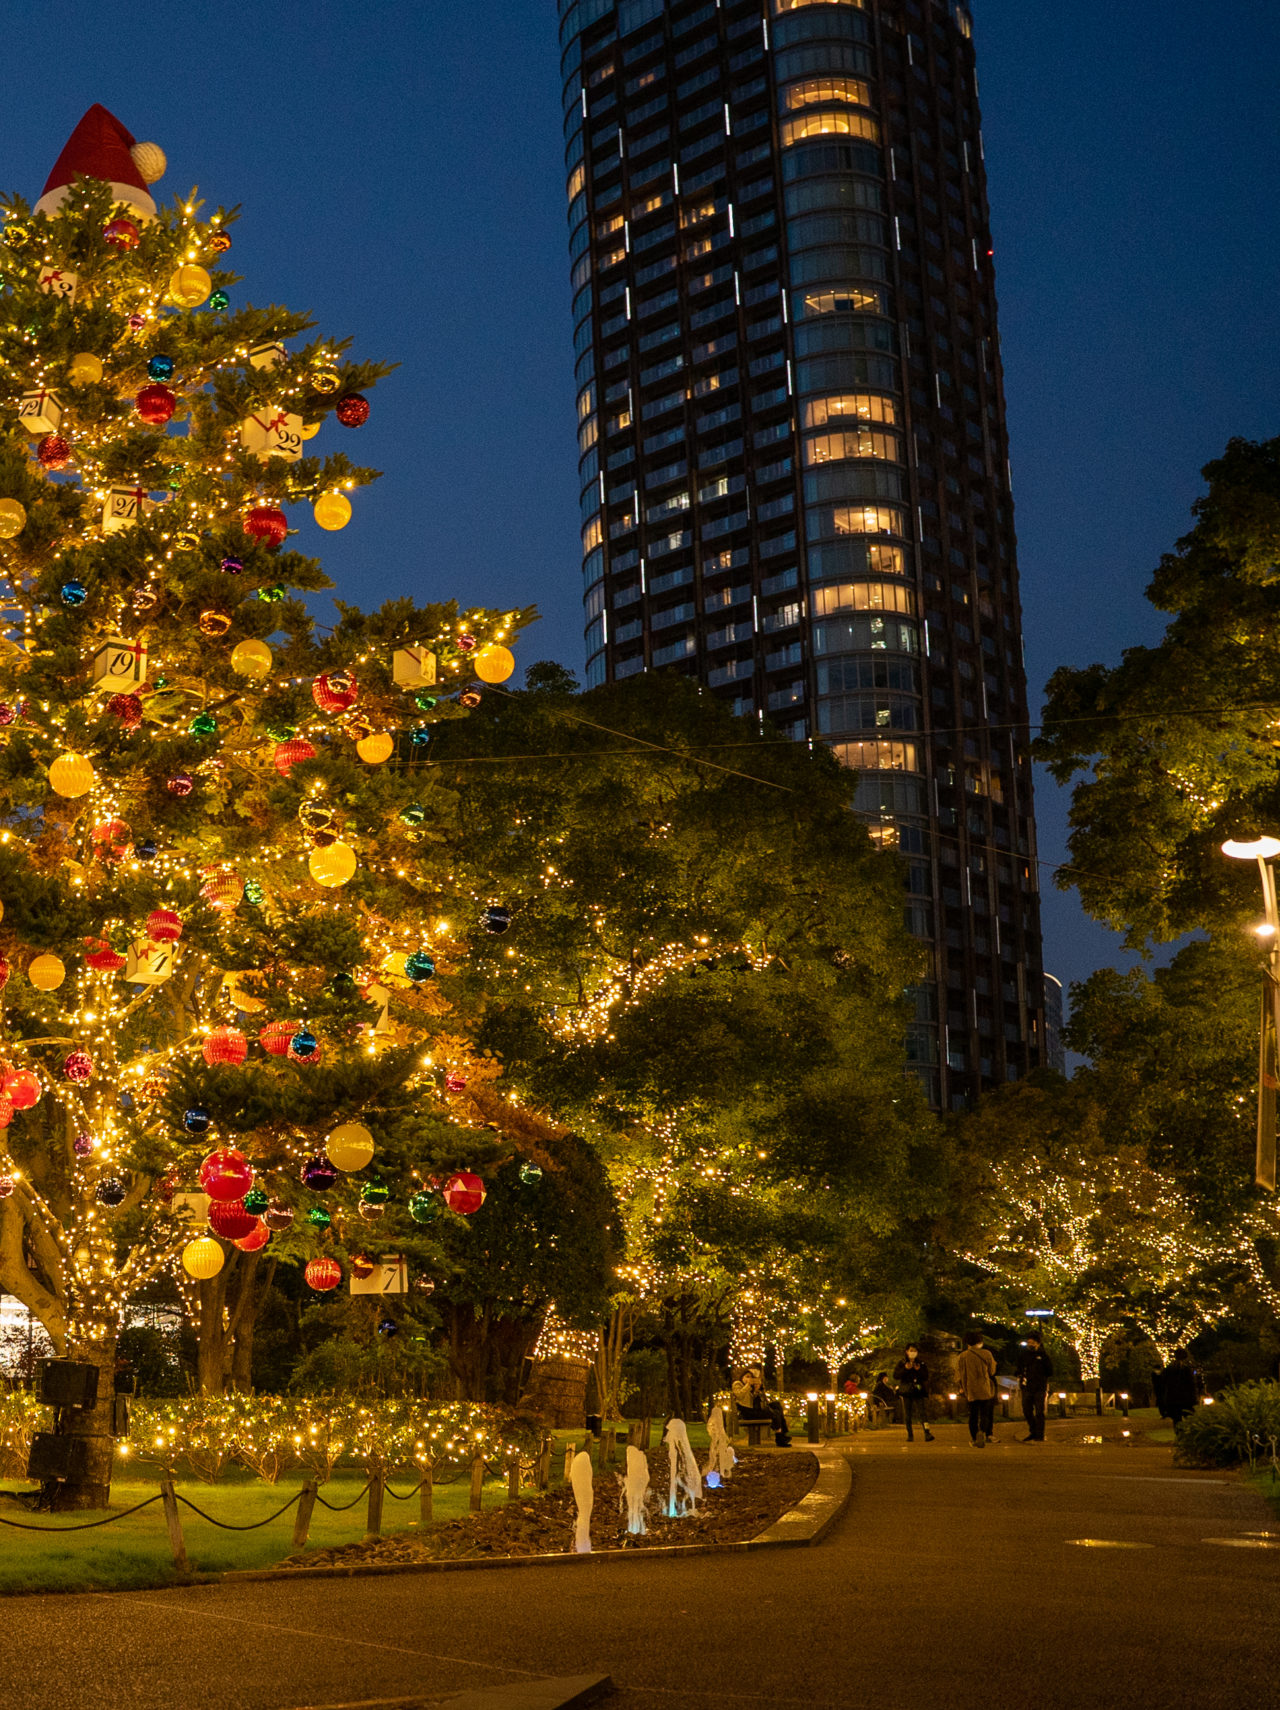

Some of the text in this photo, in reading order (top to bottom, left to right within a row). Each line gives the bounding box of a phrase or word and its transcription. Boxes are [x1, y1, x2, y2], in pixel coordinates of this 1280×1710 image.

[20, 400, 39, 417] 12
[274, 430, 301, 454] 22
[110, 651, 134, 675] 19
[383, 1266, 399, 1291] 7
